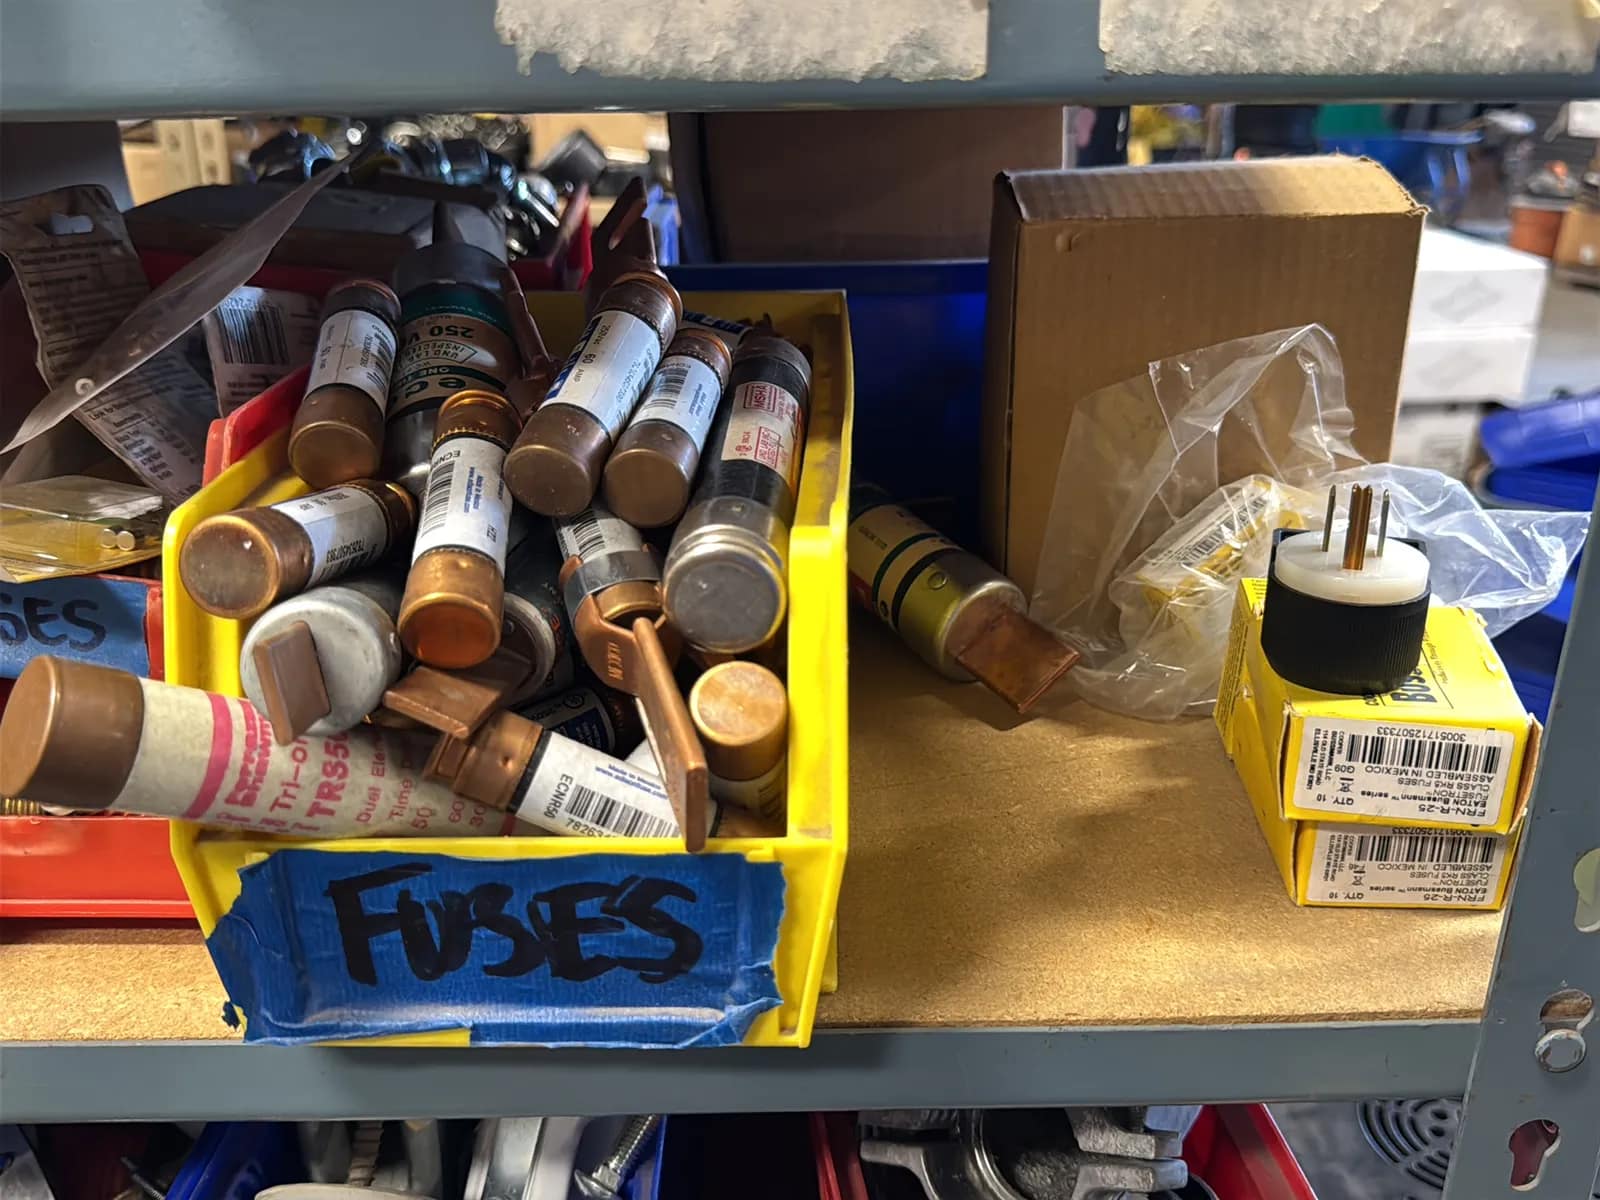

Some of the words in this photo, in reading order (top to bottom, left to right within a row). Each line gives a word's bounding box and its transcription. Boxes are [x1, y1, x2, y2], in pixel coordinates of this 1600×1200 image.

[430, 323, 473, 340] 250
[582, 350, 596, 366] 60
[753, 386, 767, 407] MSHA
[1376, 726, 1466, 742] 30051712507333
[1365, 766, 1409, 776] MEXICO
[1426, 770, 1494, 783] ASSEMBLED
[1398, 778, 1432, 787] FUSES
[1456, 782, 1490, 792] CLASS
[388, 777, 414, 821] Time
[543, 773, 574, 819] ECNR50
[1316, 794, 1326, 802] 10
[1360, 790, 1388, 798] series
[356, 788, 383, 823] Dual
[1452, 798, 1486, 808] EATON
[1418, 804, 1486, 817] FRN-R-25
[410, 807, 433, 829] 50
[1433, 863, 1493, 872] ASSEMBLED
[1424, 894, 1485, 902] FRN-R-25
[323, 862, 698, 985] FUSES
